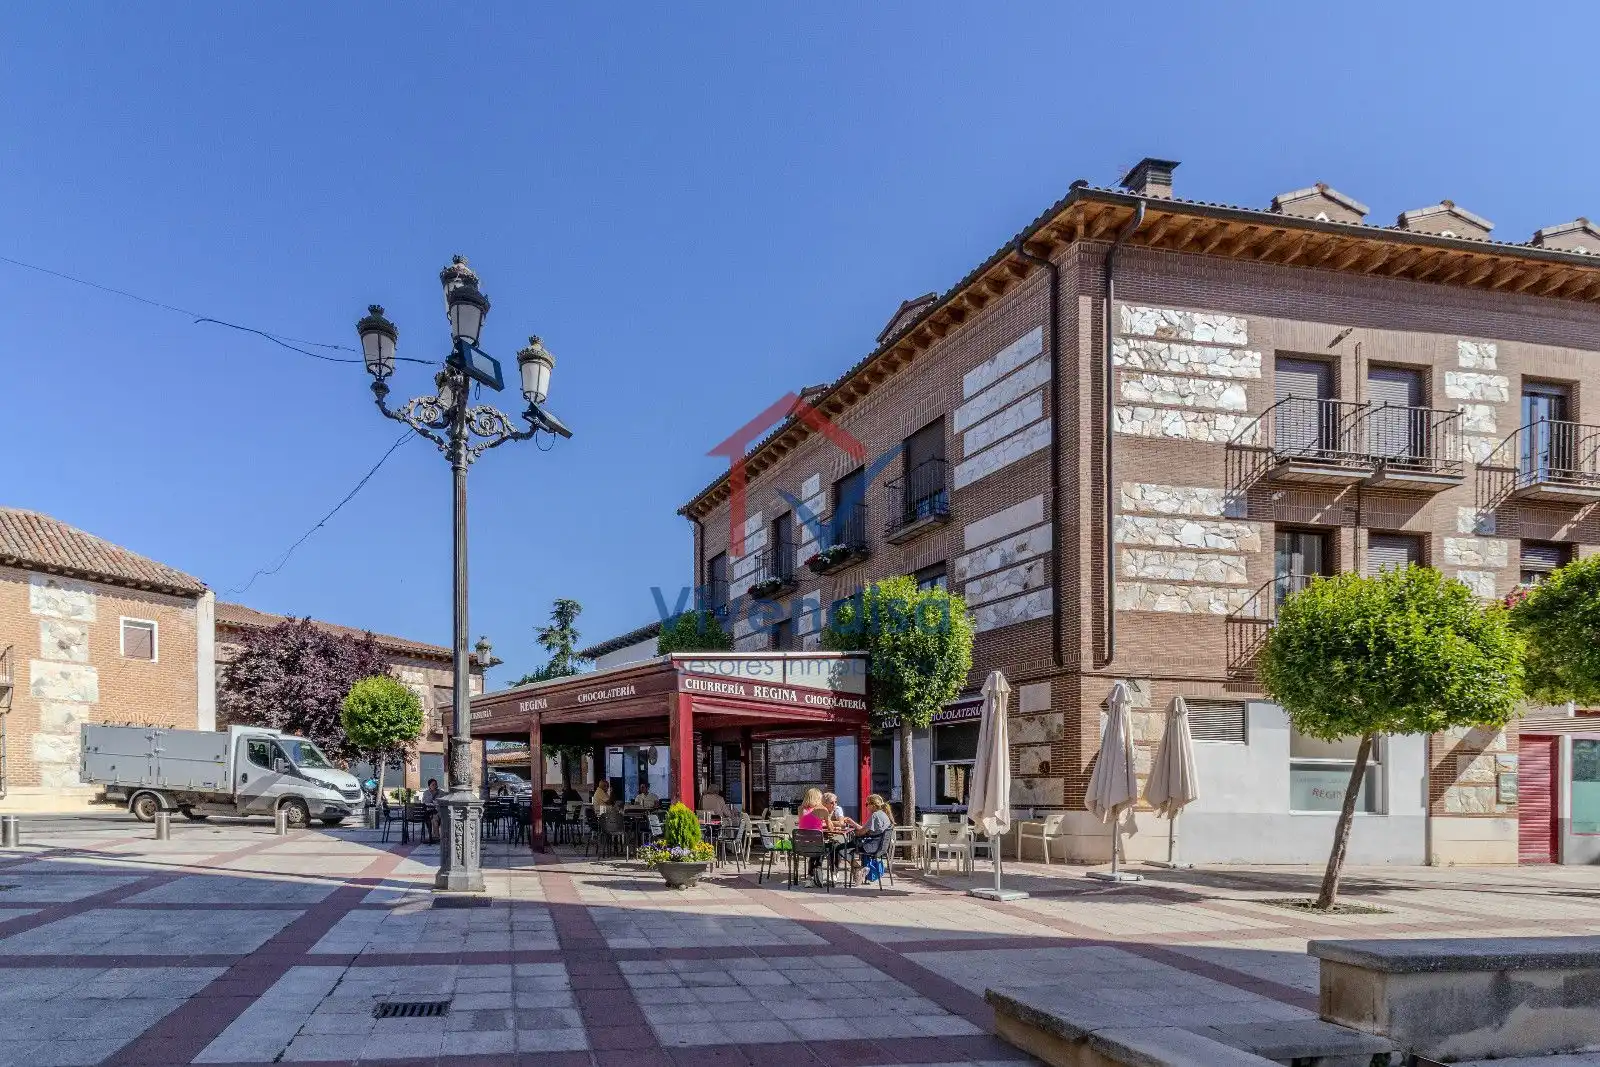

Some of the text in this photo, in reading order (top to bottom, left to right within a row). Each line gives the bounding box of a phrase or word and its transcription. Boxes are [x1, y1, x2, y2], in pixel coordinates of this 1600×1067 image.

[519, 698, 548, 713] REGINA
[577, 683, 636, 703] CHOCOLATERÍA
[685, 678, 867, 710] CHURRERÍA REGINA CHOCOLATERÍA
